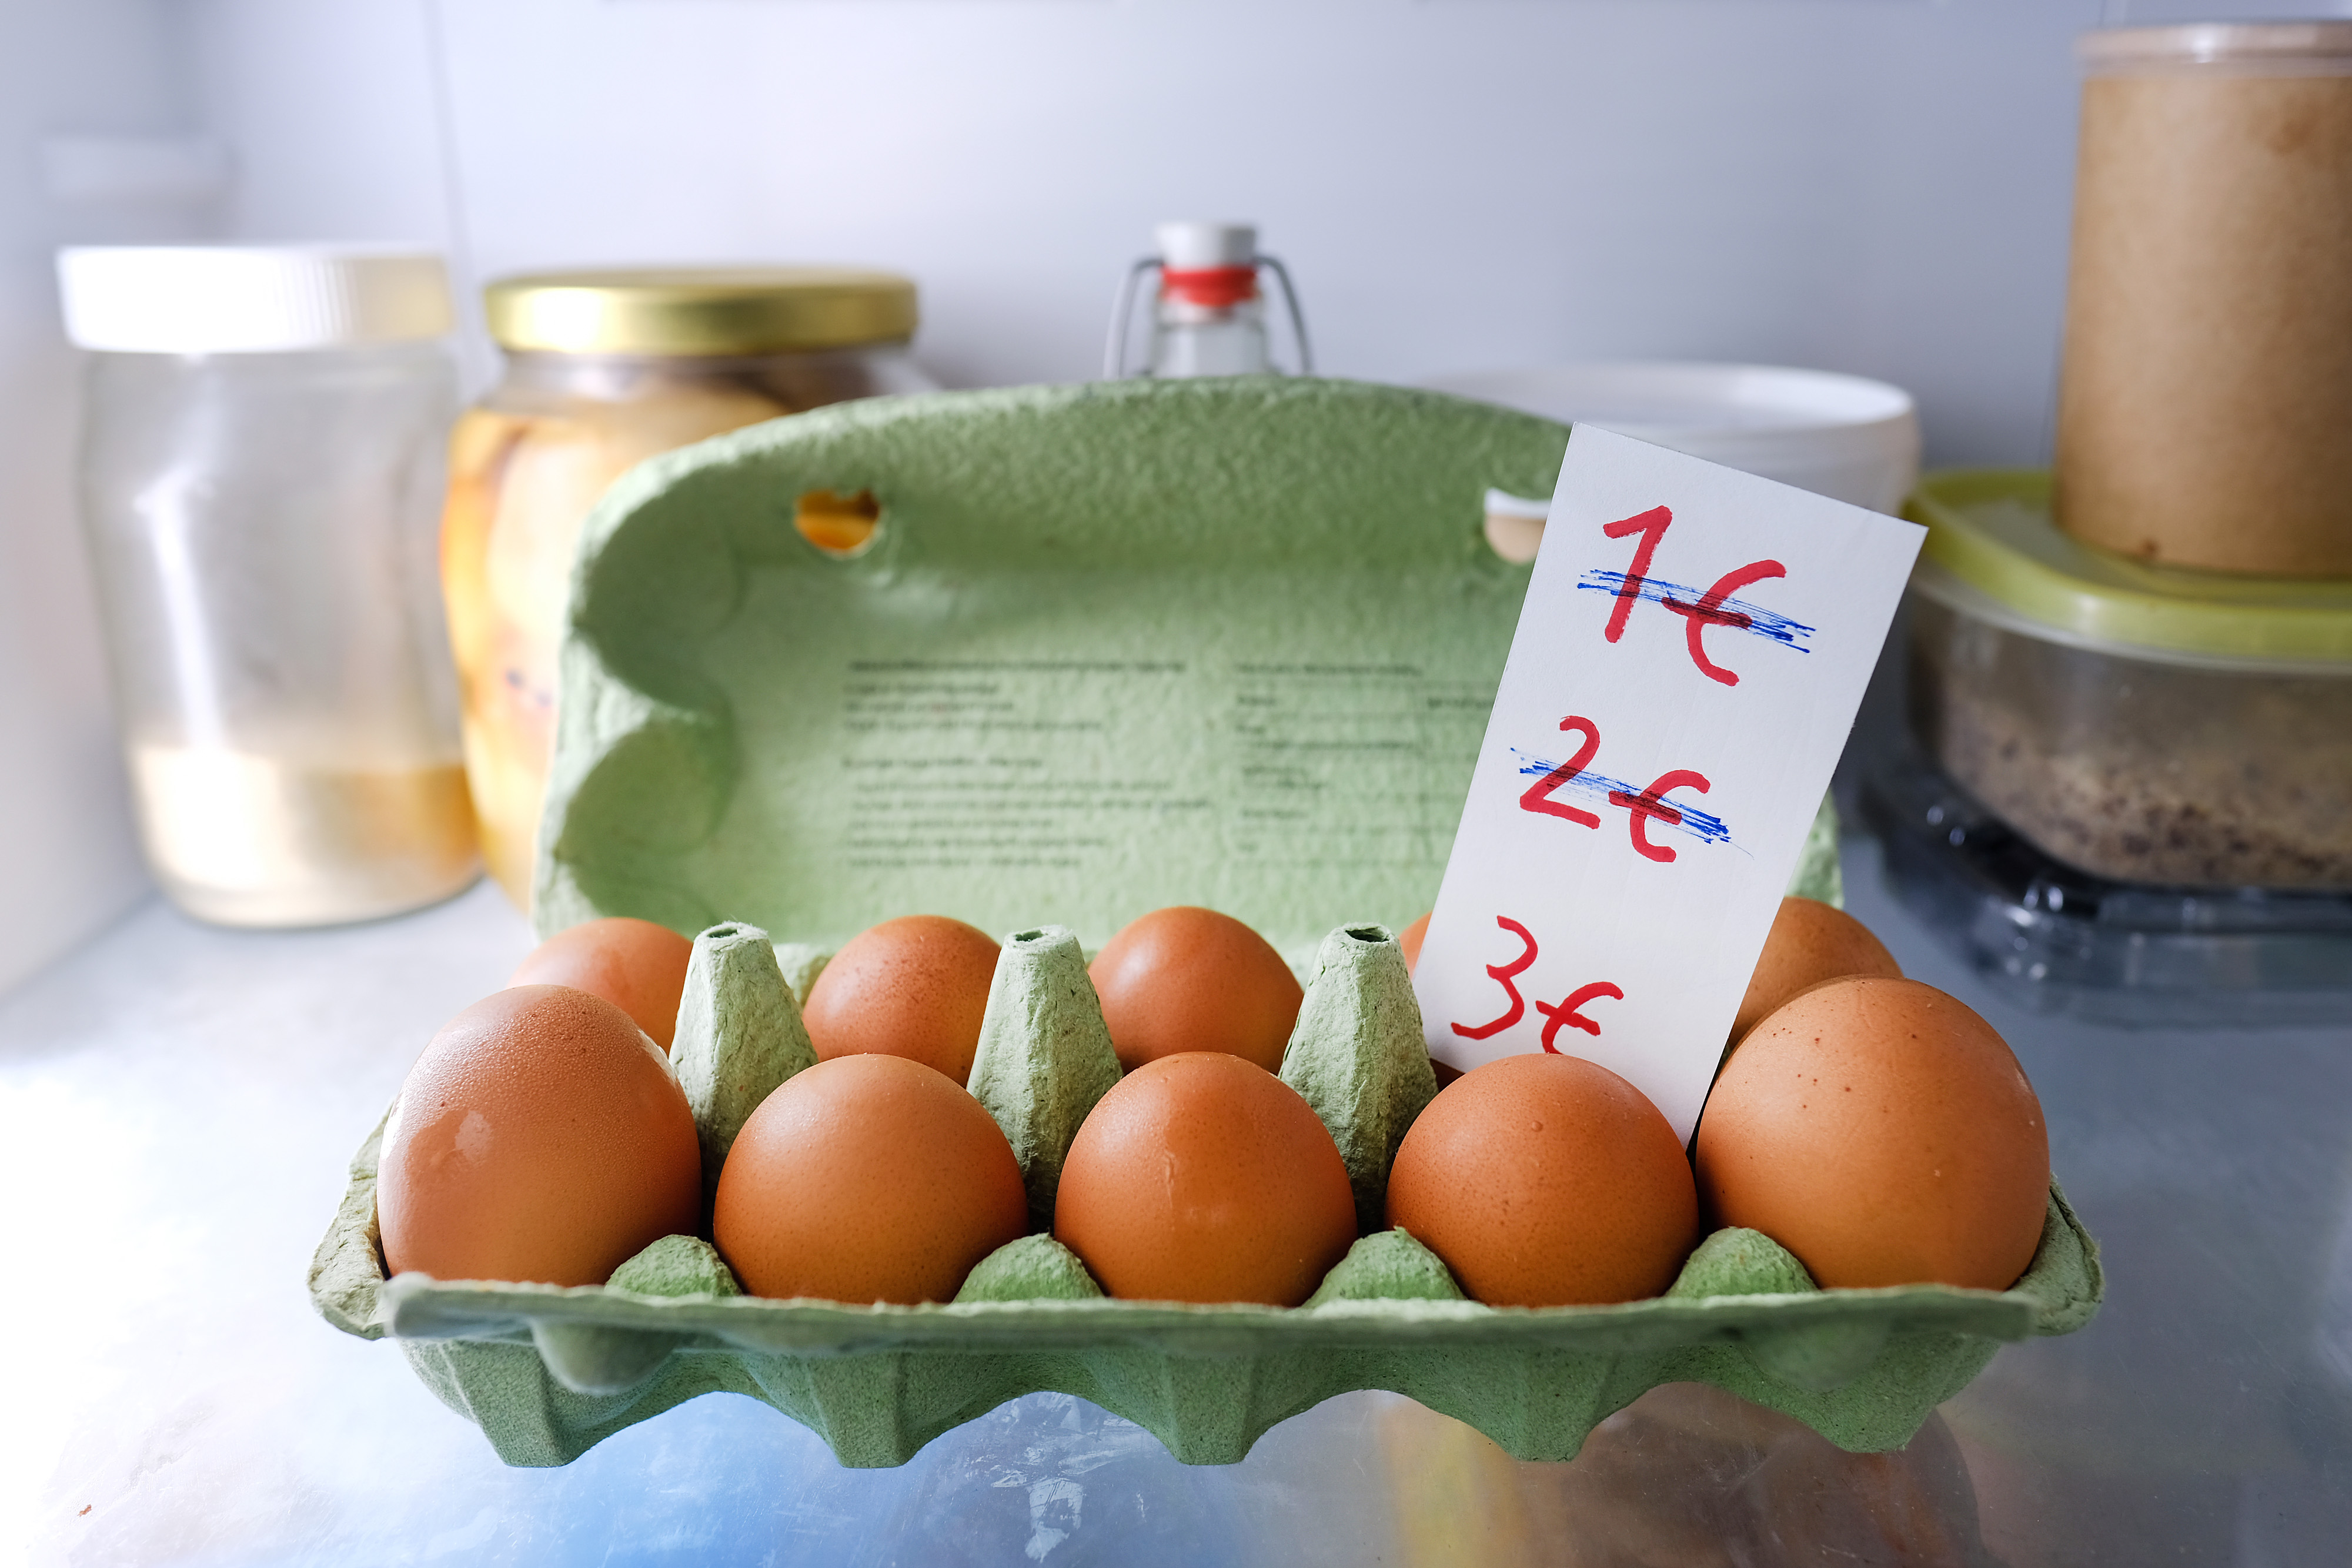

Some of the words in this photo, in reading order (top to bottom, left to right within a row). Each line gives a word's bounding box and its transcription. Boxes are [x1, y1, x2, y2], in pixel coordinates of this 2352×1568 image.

[1602, 504, 1787, 687] 1€
[1519, 714, 1712, 864] 2€
[1450, 914, 1625, 1055] 3€
